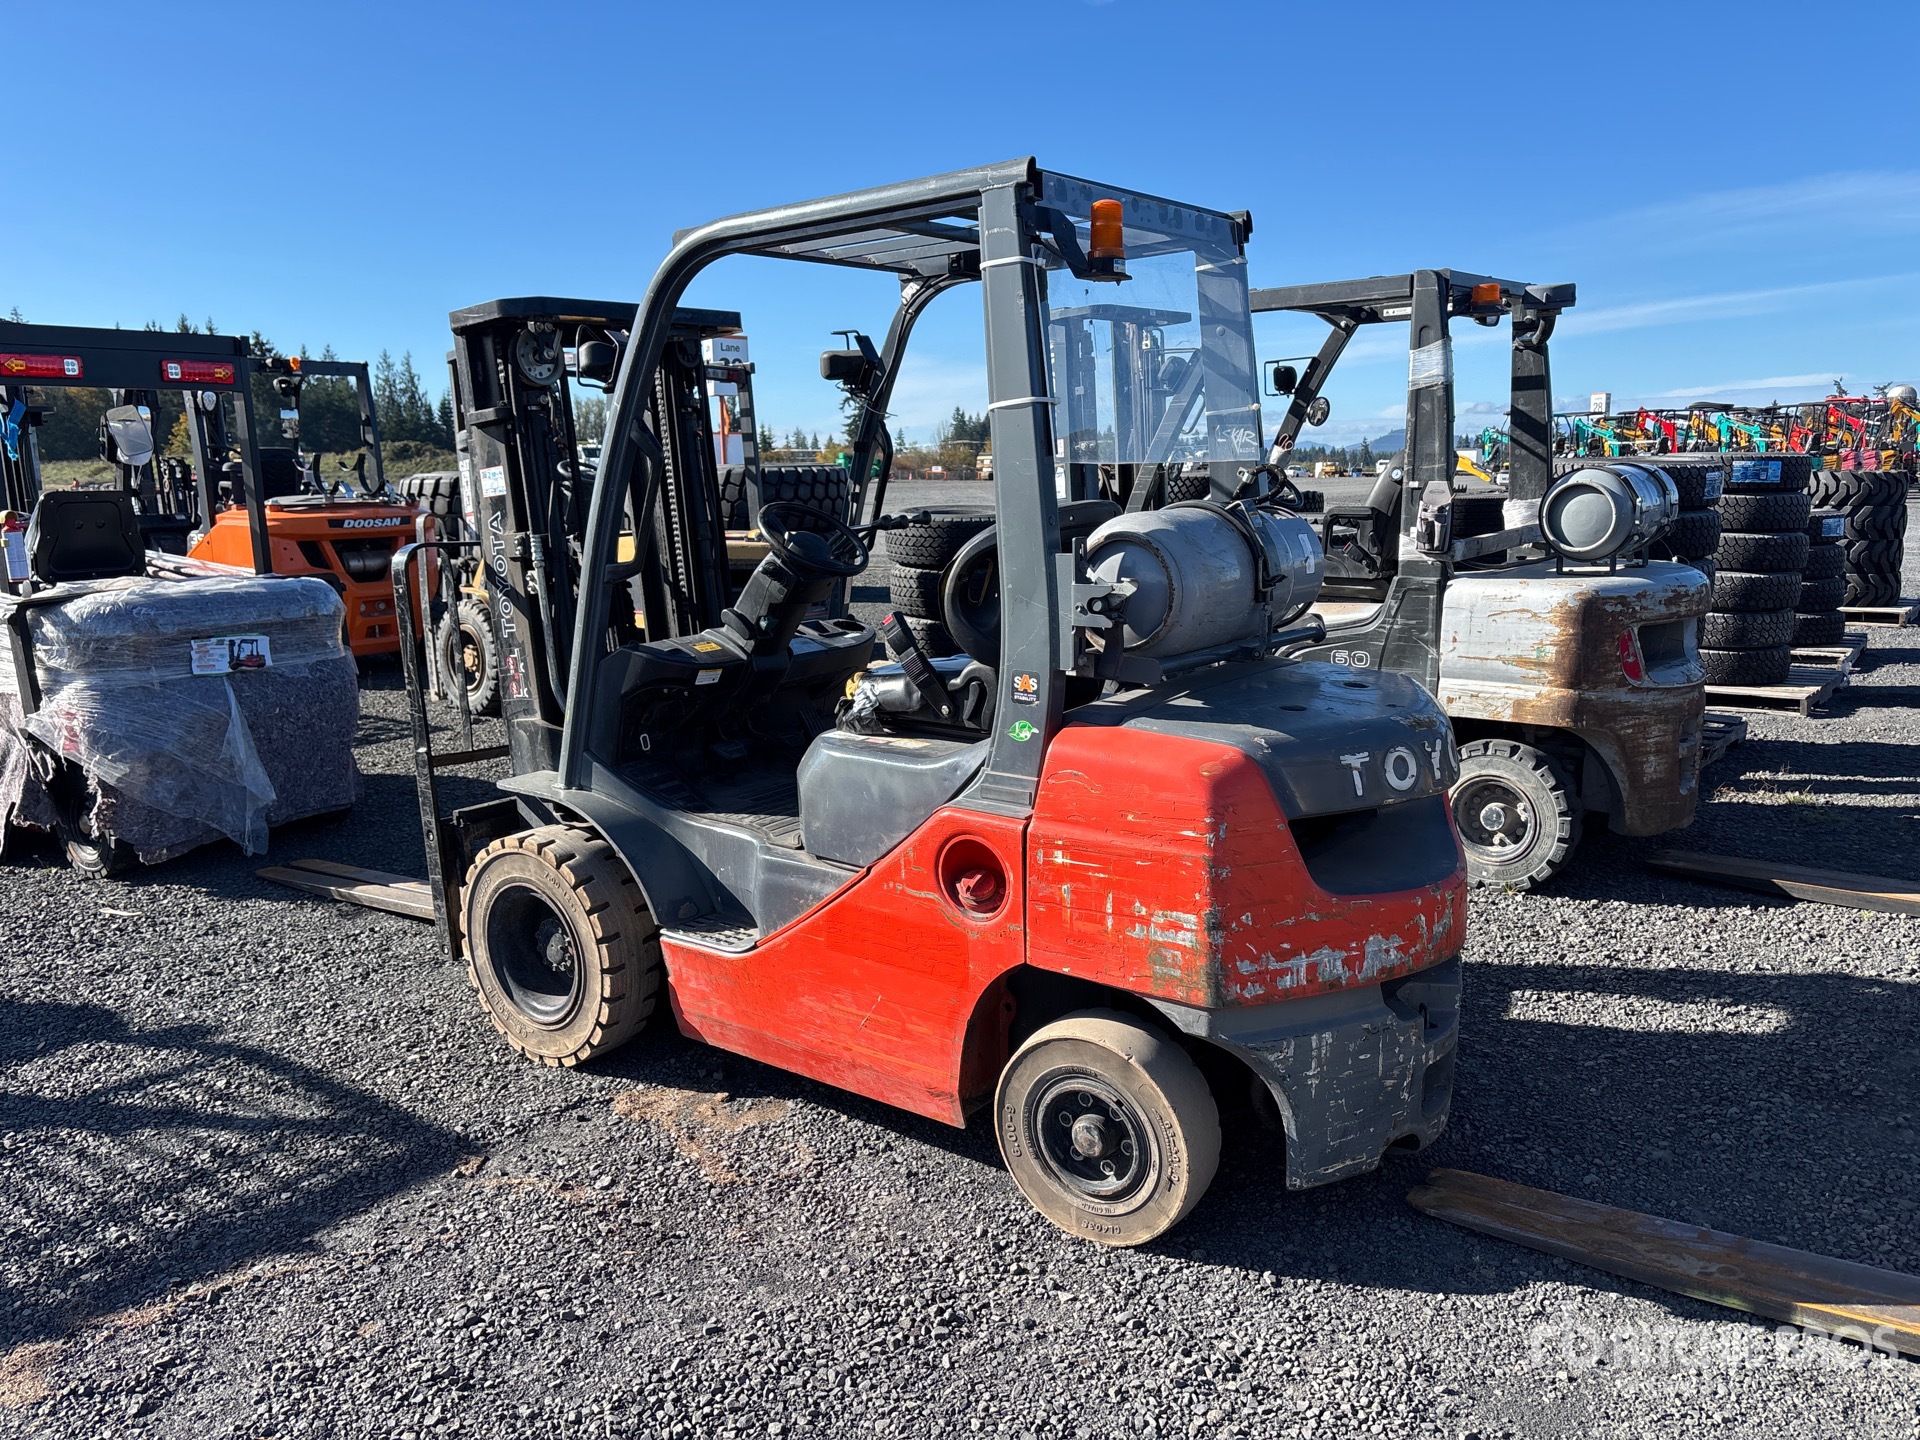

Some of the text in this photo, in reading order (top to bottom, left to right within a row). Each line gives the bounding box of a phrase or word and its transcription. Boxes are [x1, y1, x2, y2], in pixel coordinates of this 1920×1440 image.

[720, 342, 741, 352] Lane
[1593, 401, 1603, 412] 28
[343, 517, 402, 528] DOOSAN
[488, 510, 517, 639] TOYOTA
[1331, 649, 1371, 668] 60
[1013, 674, 1038, 692] SAS
[1004, 1103, 1023, 1158] 6.00-9
